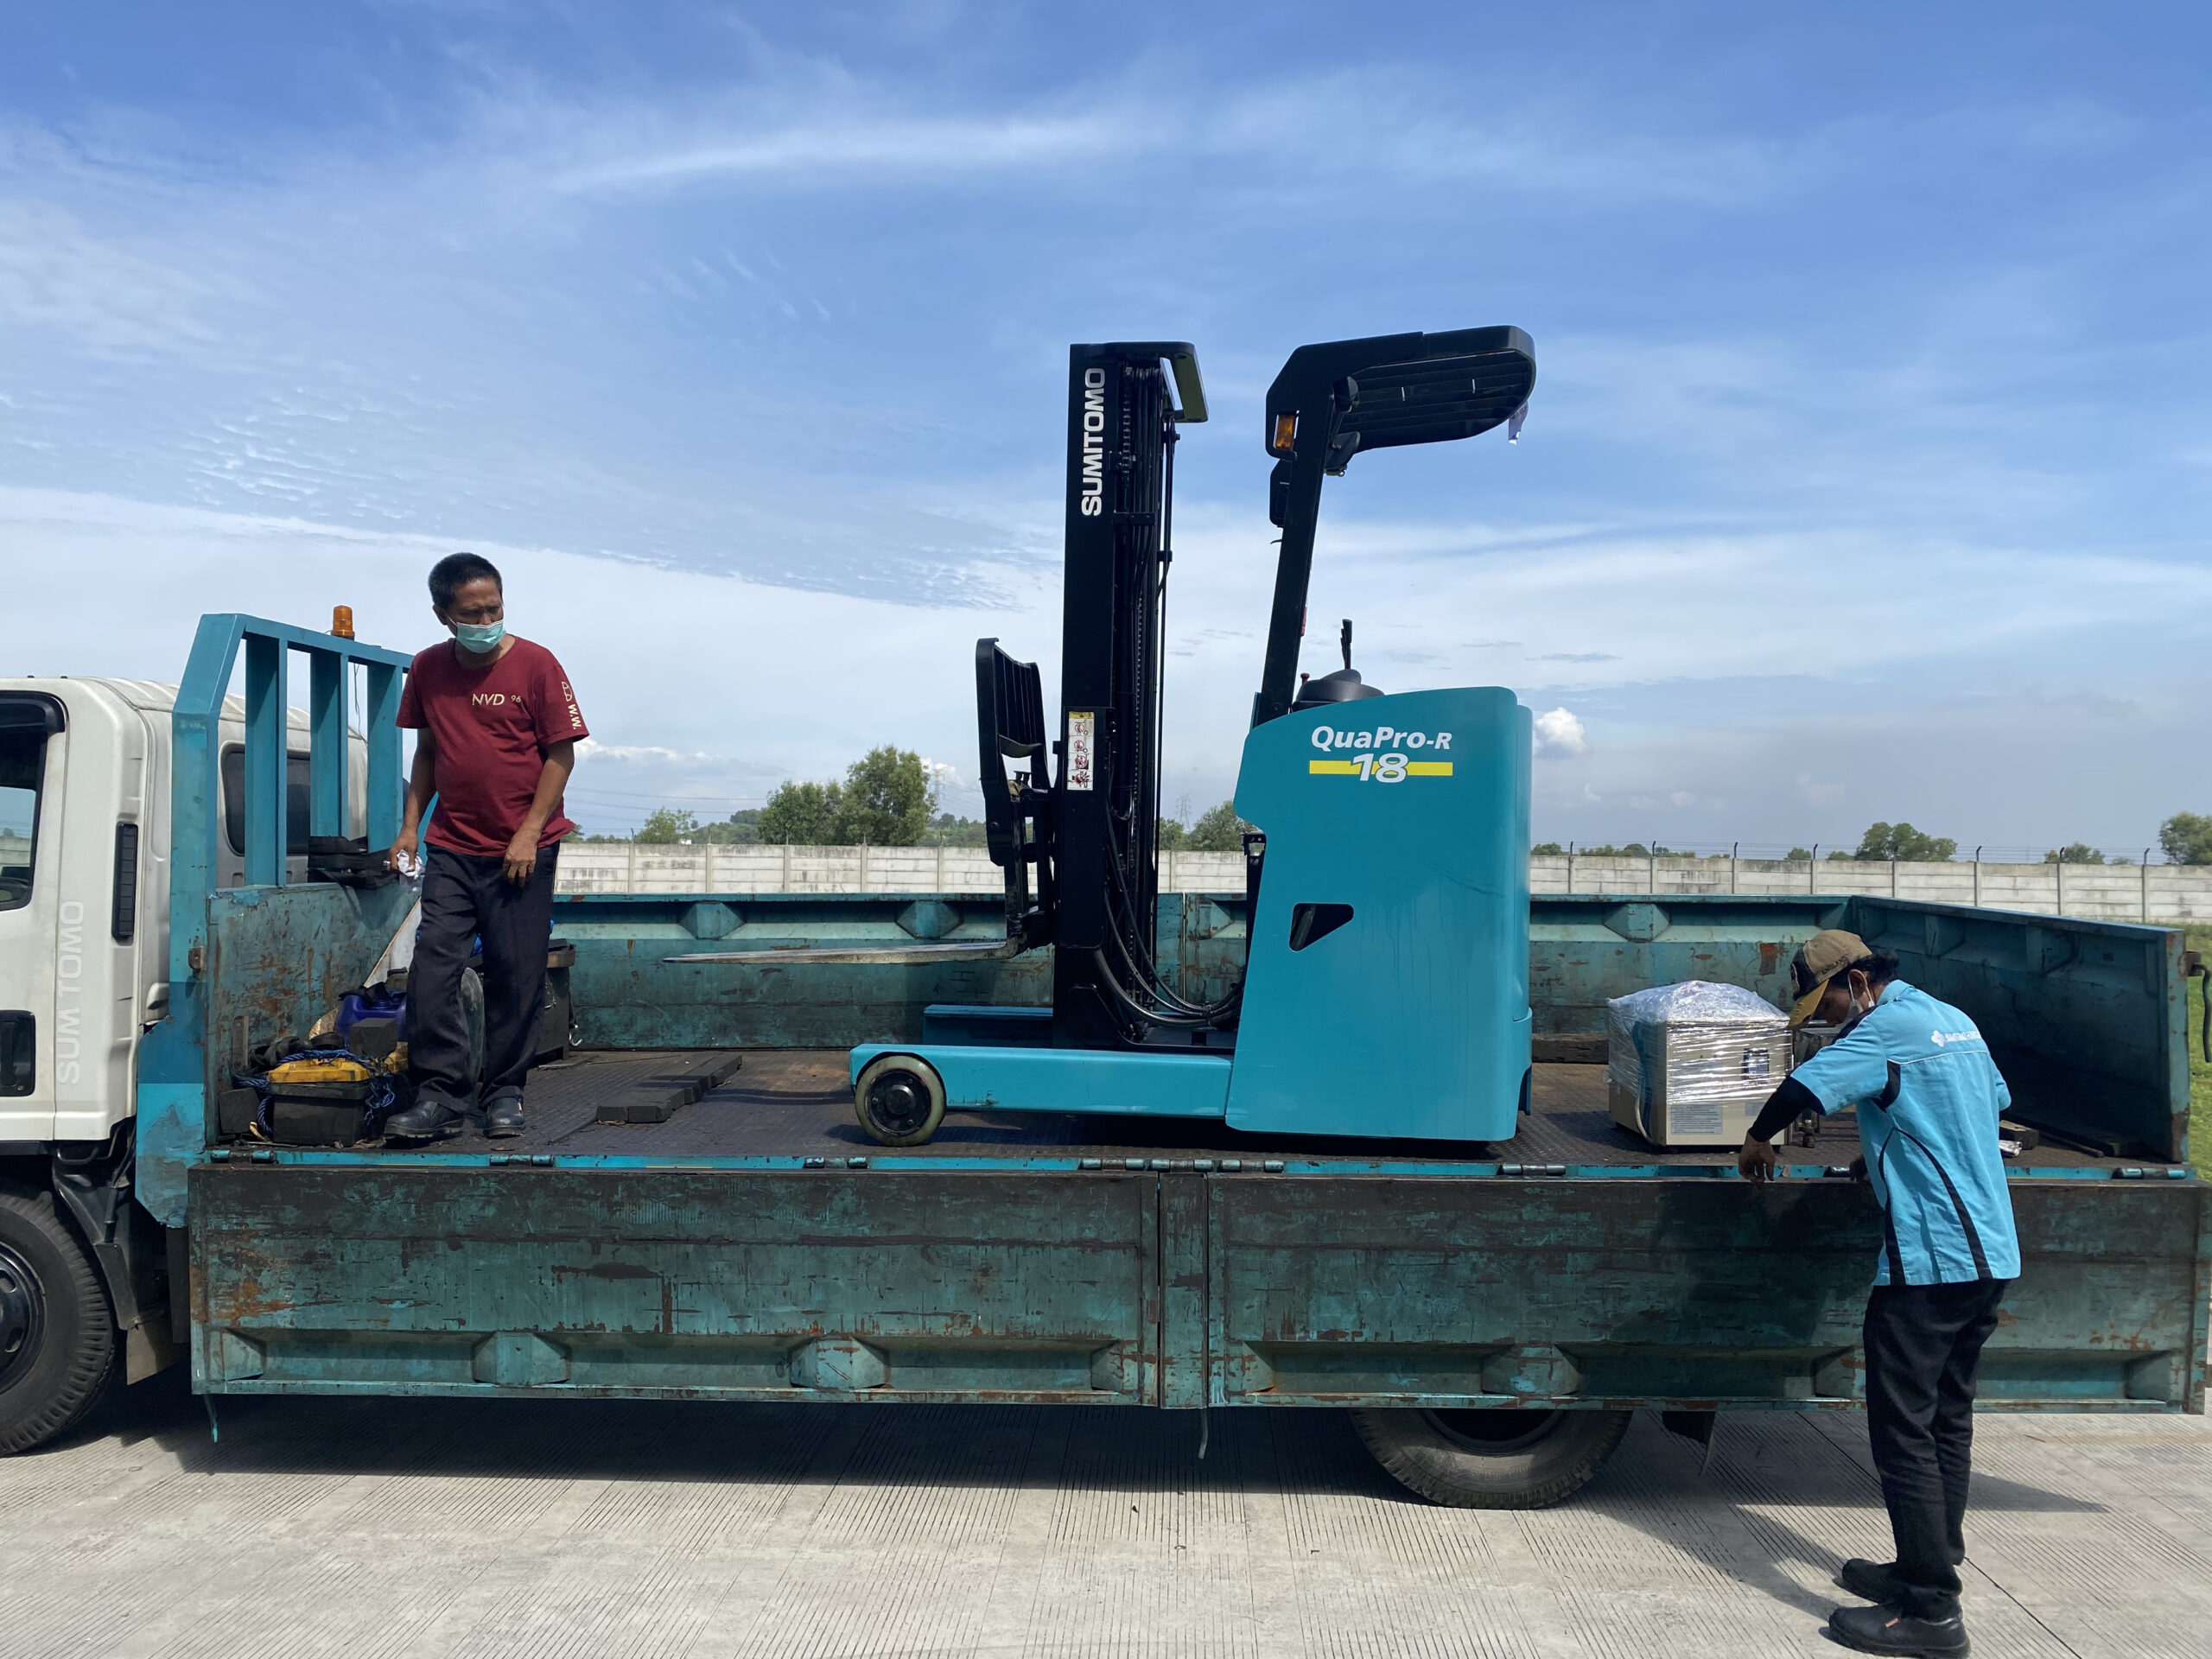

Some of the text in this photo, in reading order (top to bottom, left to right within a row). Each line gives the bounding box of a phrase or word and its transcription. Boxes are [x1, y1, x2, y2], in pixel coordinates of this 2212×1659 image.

[1081, 367, 1105, 517] SUMITOMO
[472, 693, 521, 706] NVD 96
[1311, 726, 1452, 752] QuaPro-R
[1351, 753, 1409, 784] 18
